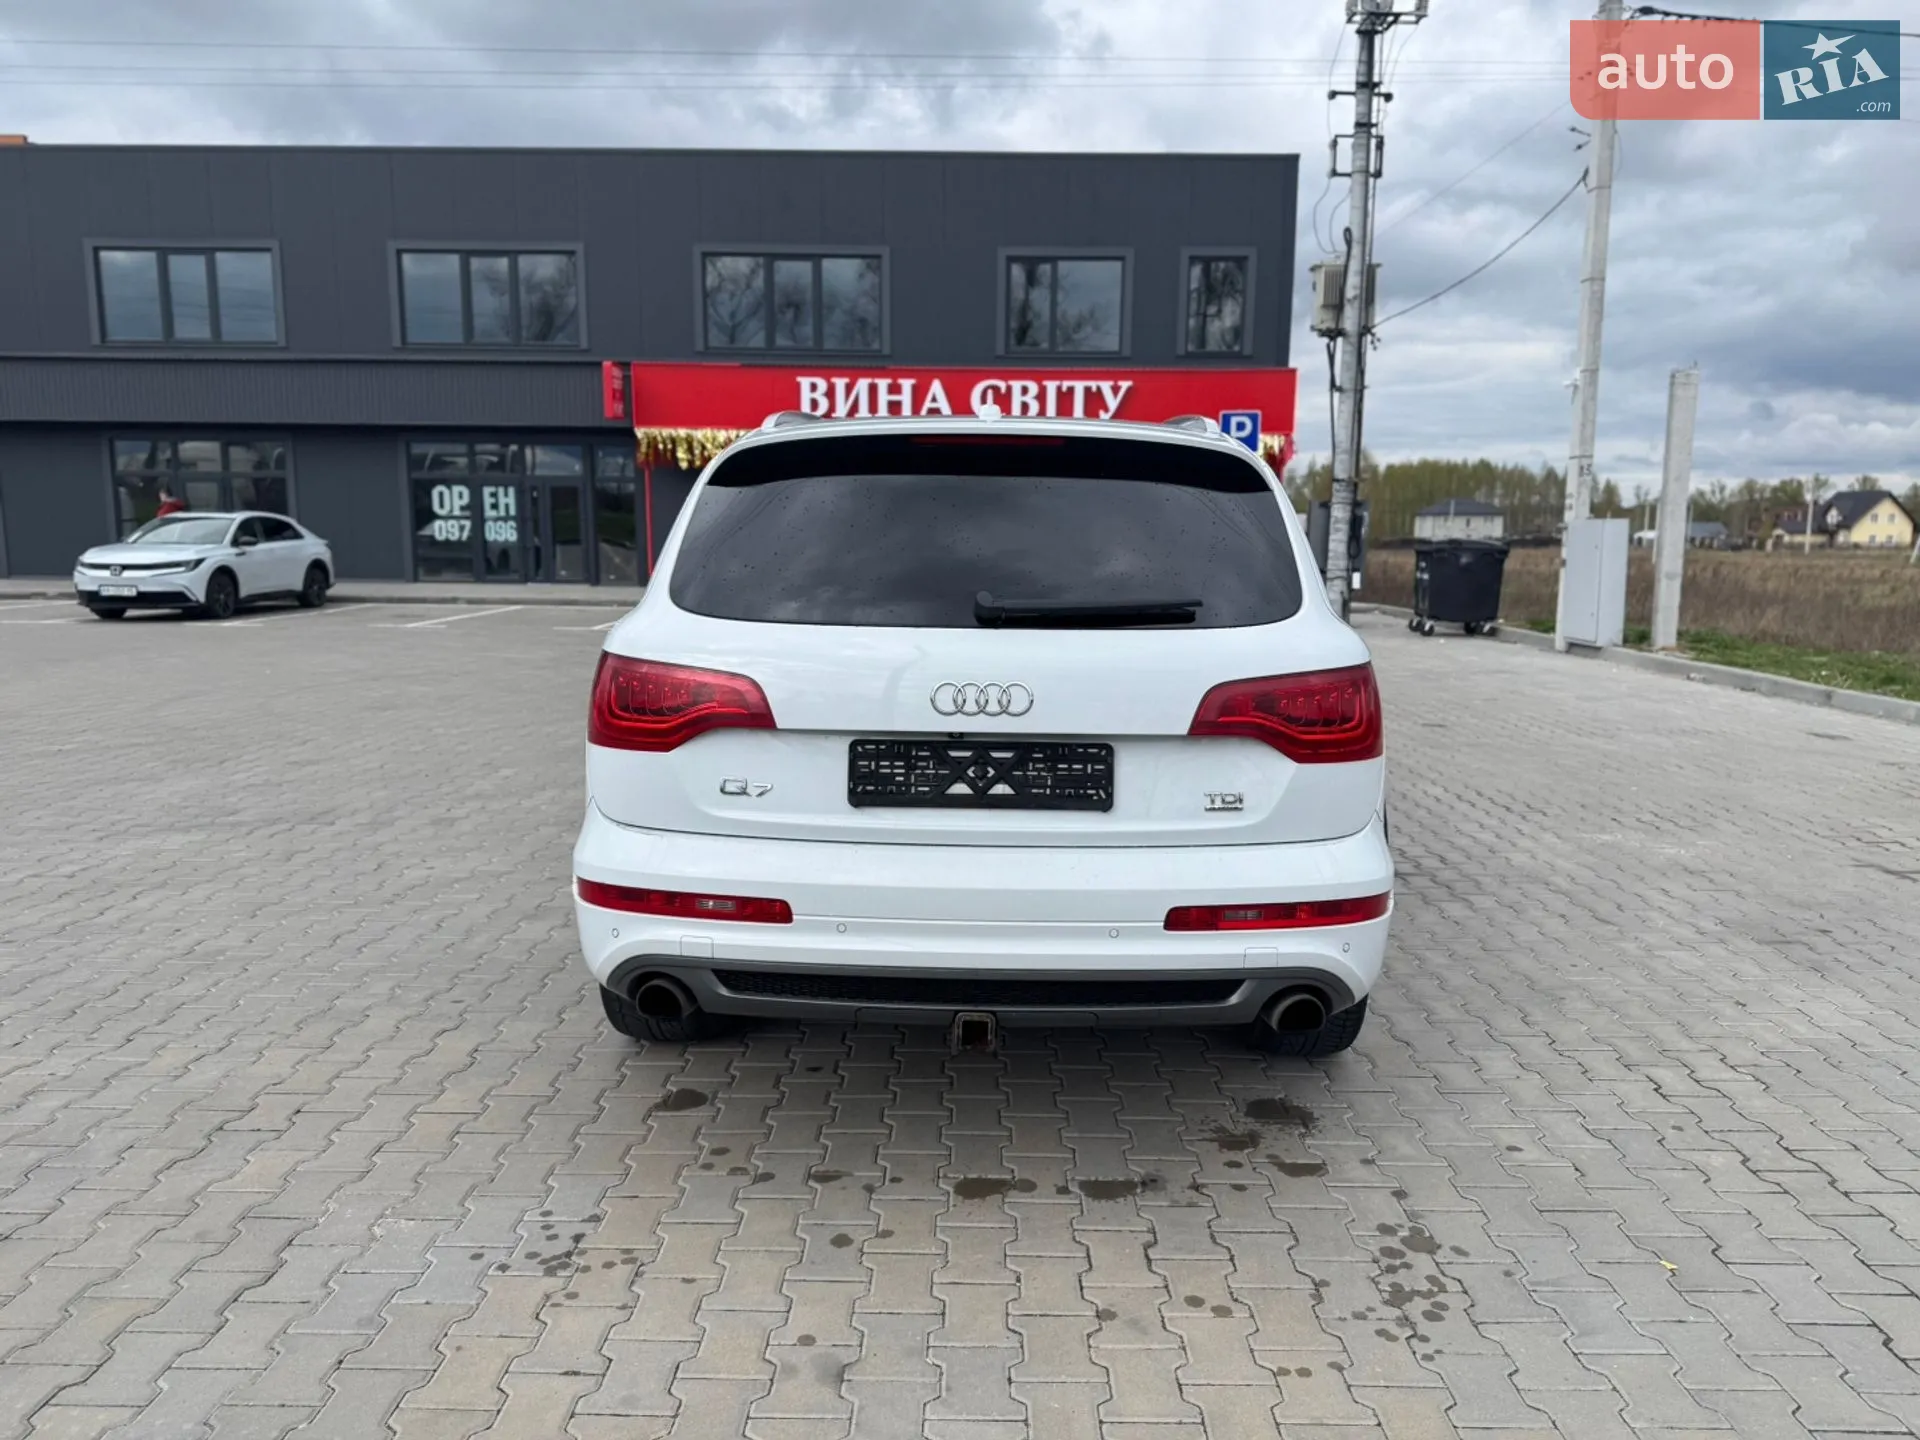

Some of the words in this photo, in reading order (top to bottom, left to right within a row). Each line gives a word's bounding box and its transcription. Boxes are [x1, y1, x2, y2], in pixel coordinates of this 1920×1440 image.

[796, 376, 953, 419] ВИНА
[970, 379, 1133, 420] СВІТУ
[1230, 416, 1253, 438] P
[434, 520, 471, 541] 097
[484, 520, 518, 542] 096
[719, 777, 773, 798] Q7
[1203, 792, 1244, 805] TDI
